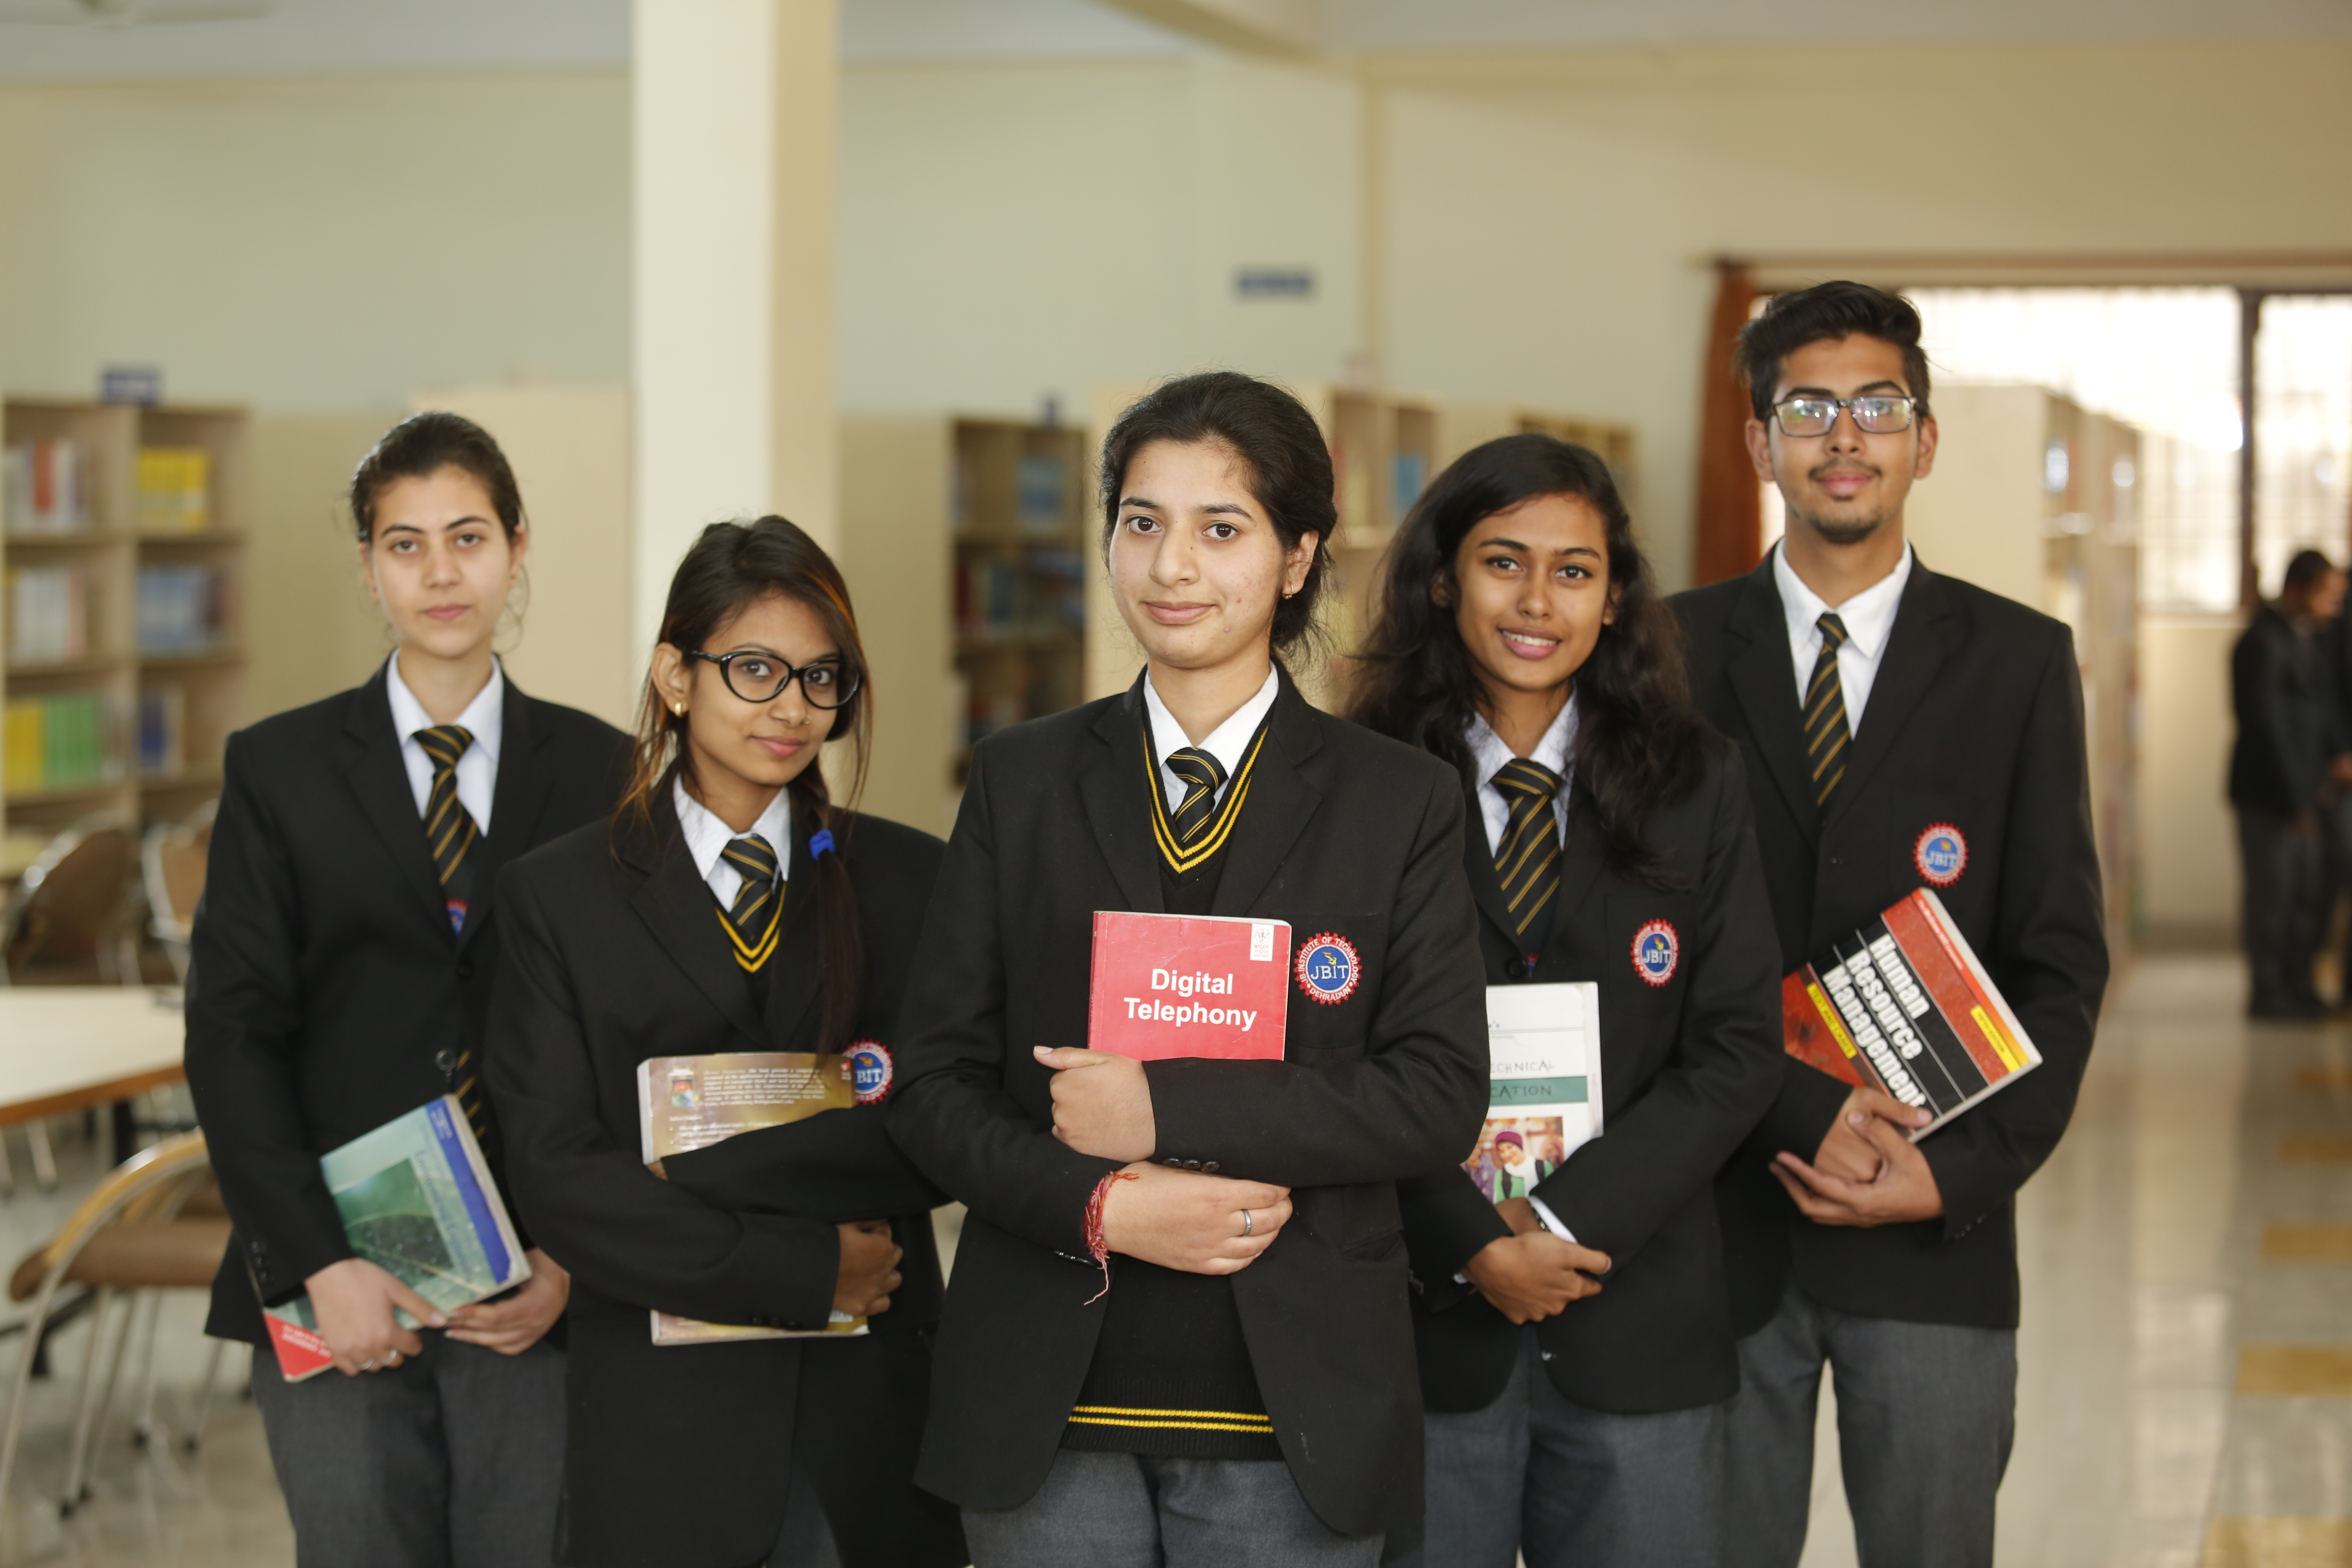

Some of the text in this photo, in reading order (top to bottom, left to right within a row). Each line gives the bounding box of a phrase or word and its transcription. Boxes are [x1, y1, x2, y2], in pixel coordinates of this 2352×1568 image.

[1298, 939, 1319, 972] INSTITUTE
[1335, 938, 1359, 984] TECHNOLOGY
[1644, 949, 1670, 963] JBIT
[1152, 969, 1233, 997] Digital
[1310, 965, 1349, 980] JBIT
[1869, 933, 1930, 1020] Human
[1309, 986, 1351, 1001] DEHRADUN
[1124, 997, 1257, 1031] Telephony
[1846, 949, 1923, 1060] Resource
[1822, 964, 1927, 1107] Management
[856, 1068, 882, 1083] BIT
[1490, 1060, 1555, 1074] ECHNICAL
[1490, 1085, 1551, 1099] CATION
